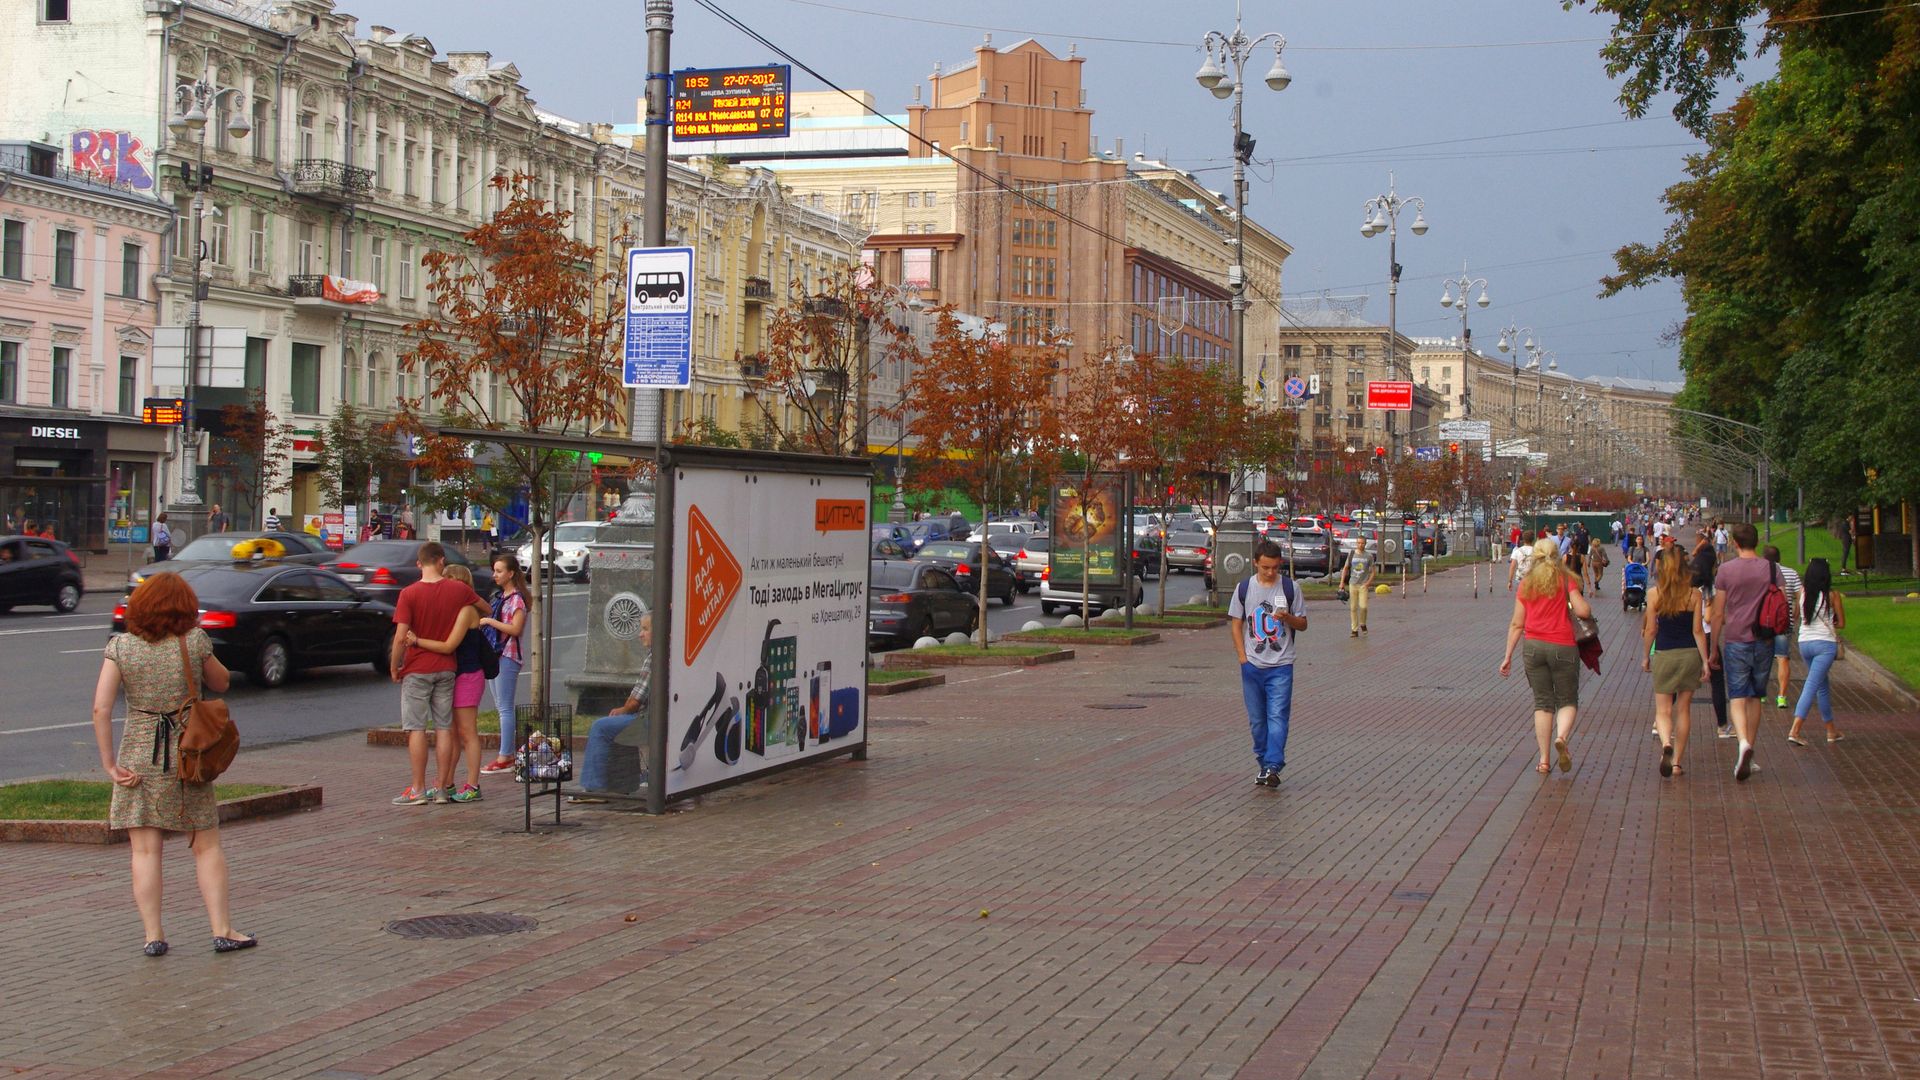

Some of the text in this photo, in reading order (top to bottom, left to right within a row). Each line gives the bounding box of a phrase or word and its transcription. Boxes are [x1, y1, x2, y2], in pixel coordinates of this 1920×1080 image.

[723, 74, 775, 86] 27-07-2017
[700, 89, 724, 97] КІНЦЕВА
[725, 88, 751, 96] ЗУПИНКА
[762, 96, 771, 106] 11
[775, 95, 784, 105] 17
[760, 108, 771, 118] 07
[773, 107, 785, 118] 07
[31, 426, 81, 439] DIESEL
[817, 505, 864, 525] ЦИТРУС
[113, 529, 130, 539] SALE
[751, 552, 844, 570] Ах ти ж маленький бешкетун!
[694, 553, 715, 594] ДАЛІ
[702, 577, 715, 600] НЕ
[750, 579, 863, 607] Тоді заходь в МегаЦитрус
[698, 581, 725, 626] ЧИТАЙ
[812, 612, 819, 624] на
[820, 607, 854, 625] Хрещатику,
